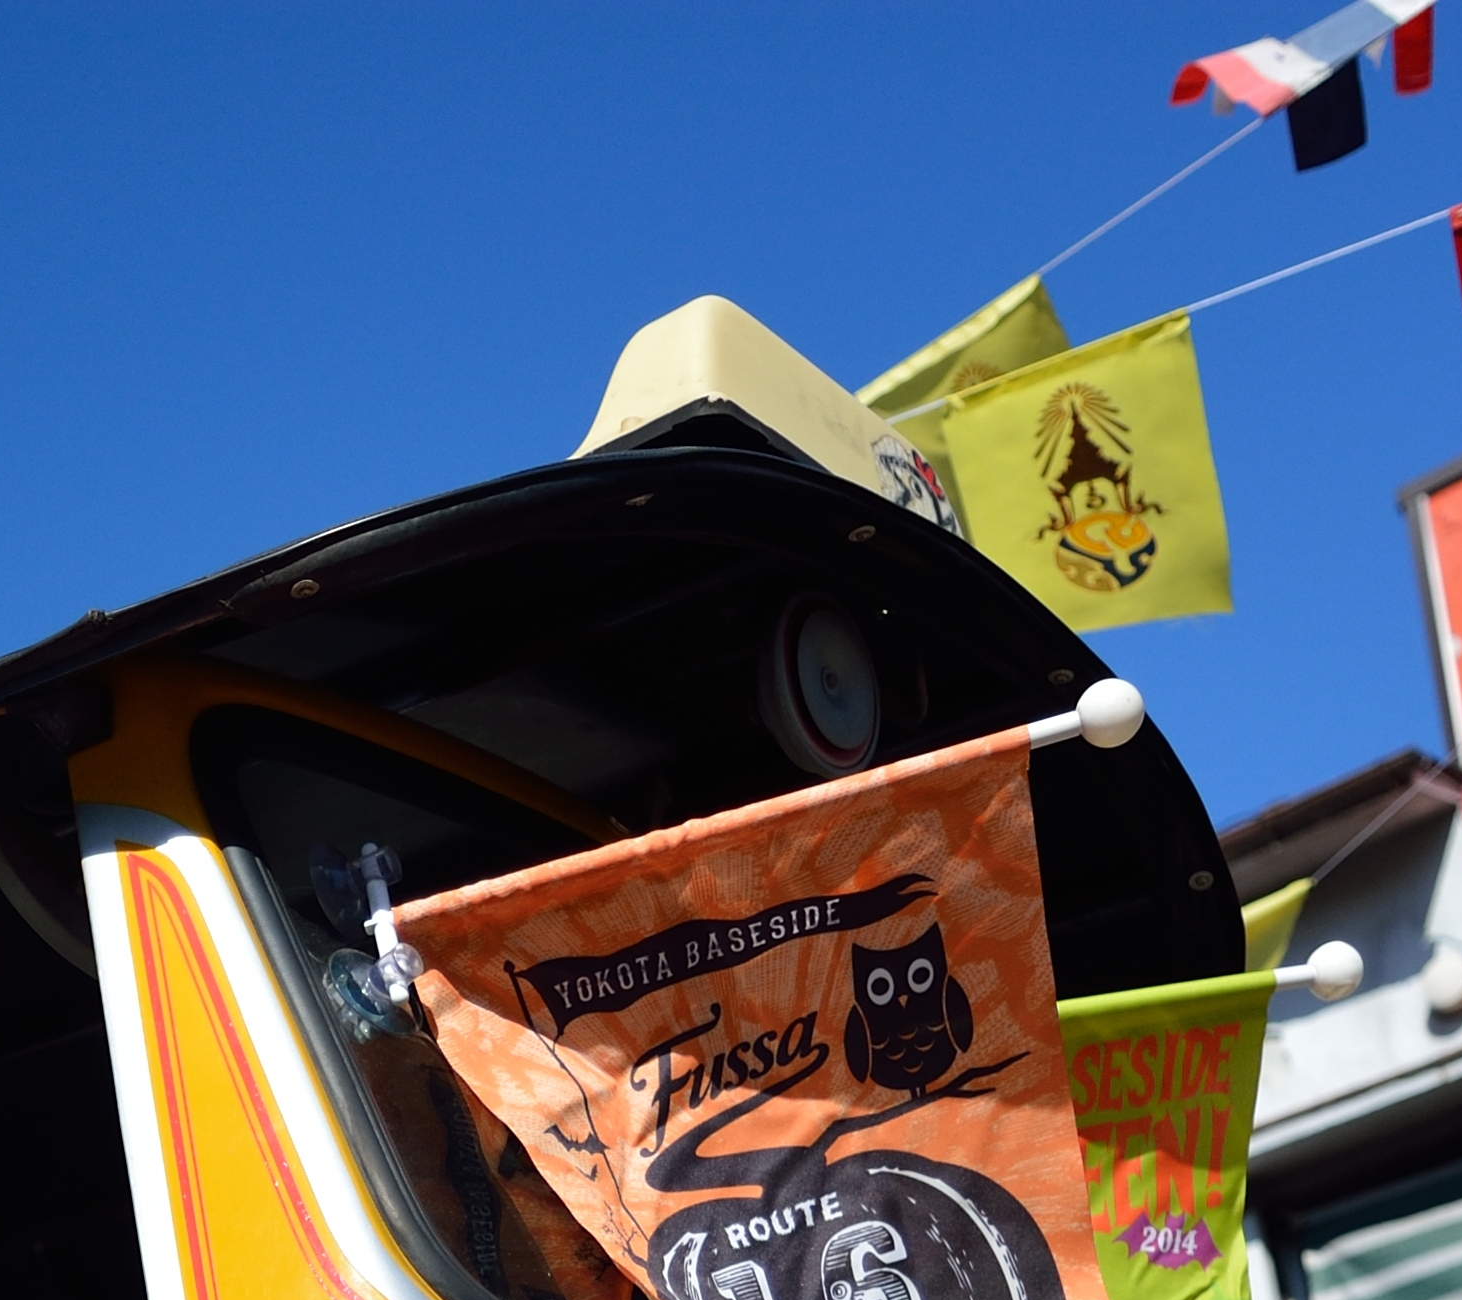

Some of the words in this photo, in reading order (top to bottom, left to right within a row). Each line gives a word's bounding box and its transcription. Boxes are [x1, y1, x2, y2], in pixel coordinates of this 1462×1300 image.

[554, 951, 674, 1010] YOKOTA
[685, 898, 841, 969] BASESIDE
[630, 1002, 830, 1158] Fussa
[724, 1191, 844, 1250] ROUTE
[1140, 1225, 1198, 1257] 2014
